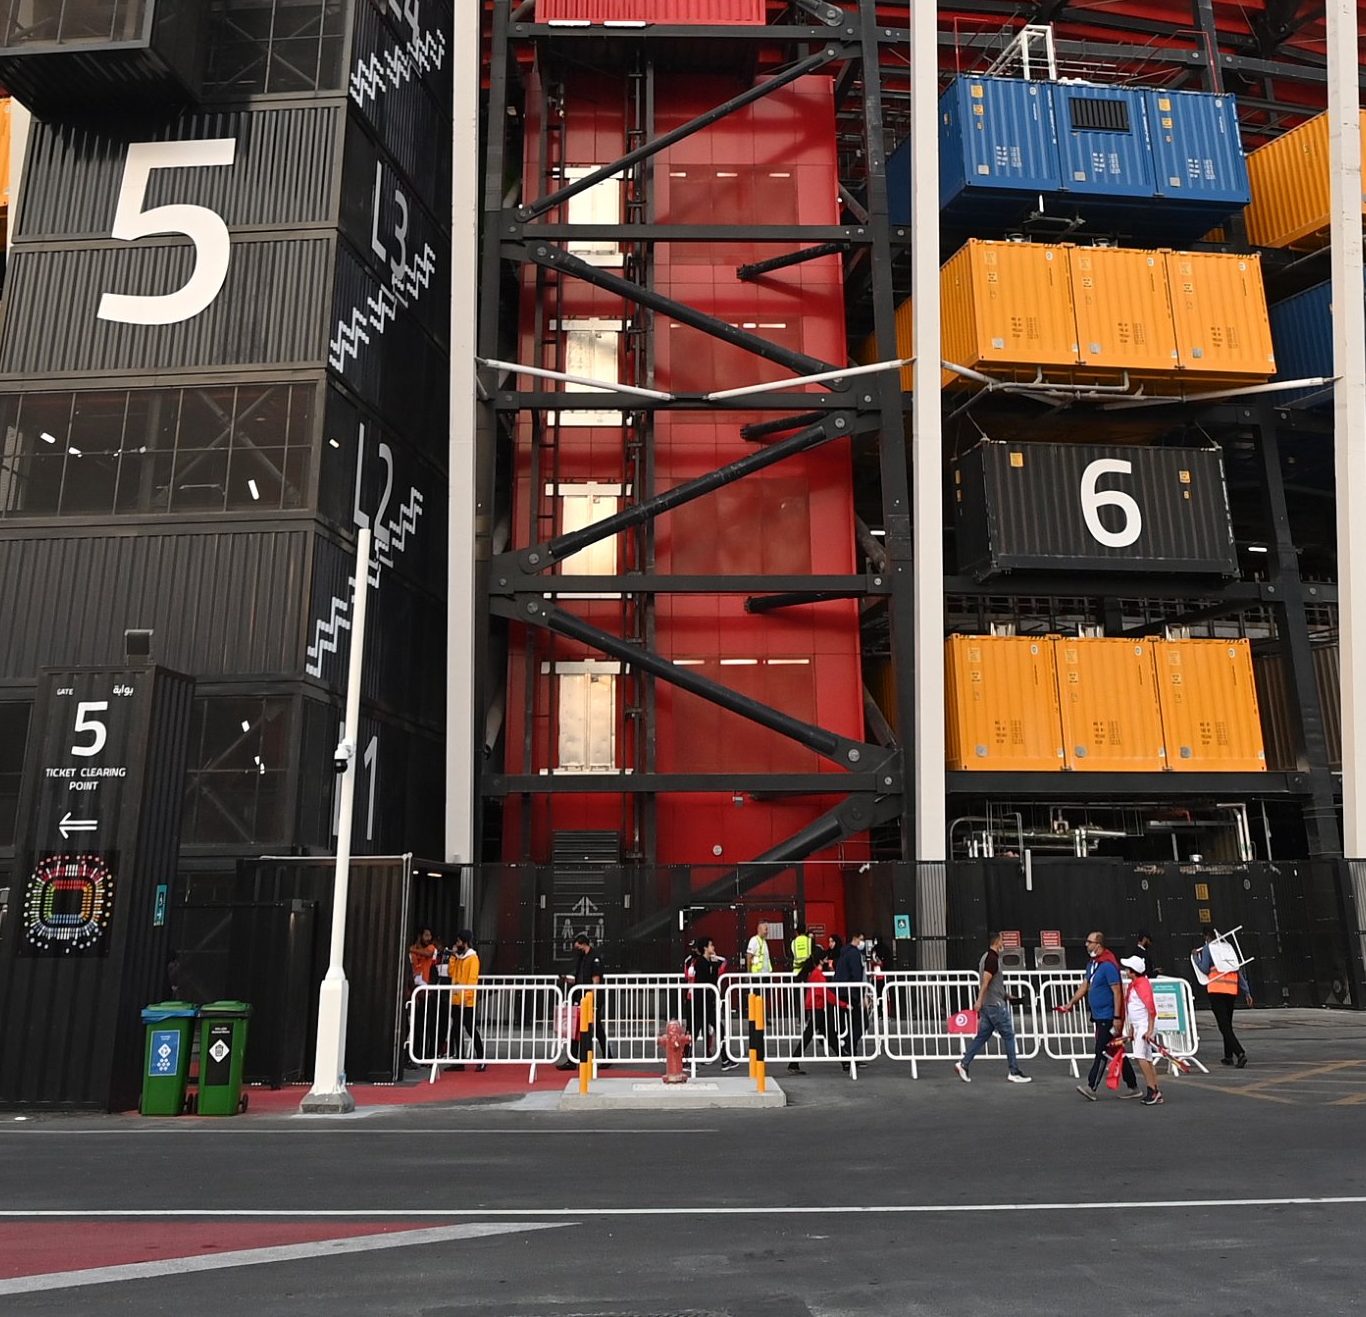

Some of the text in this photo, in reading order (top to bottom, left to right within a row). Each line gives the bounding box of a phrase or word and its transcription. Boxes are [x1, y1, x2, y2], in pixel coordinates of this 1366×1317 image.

[96, 136, 236, 325] 5
[371, 160, 409, 280] L3
[352, 421, 394, 542] L2
[1079, 458, 1142, 548] 6
[56, 687, 74, 696] GATE
[112, 684, 134, 697] بوابة
[70, 700, 109, 757] 5
[45, 767, 127, 778] TICKET CLEARING
[68, 781, 99, 791] POINT
